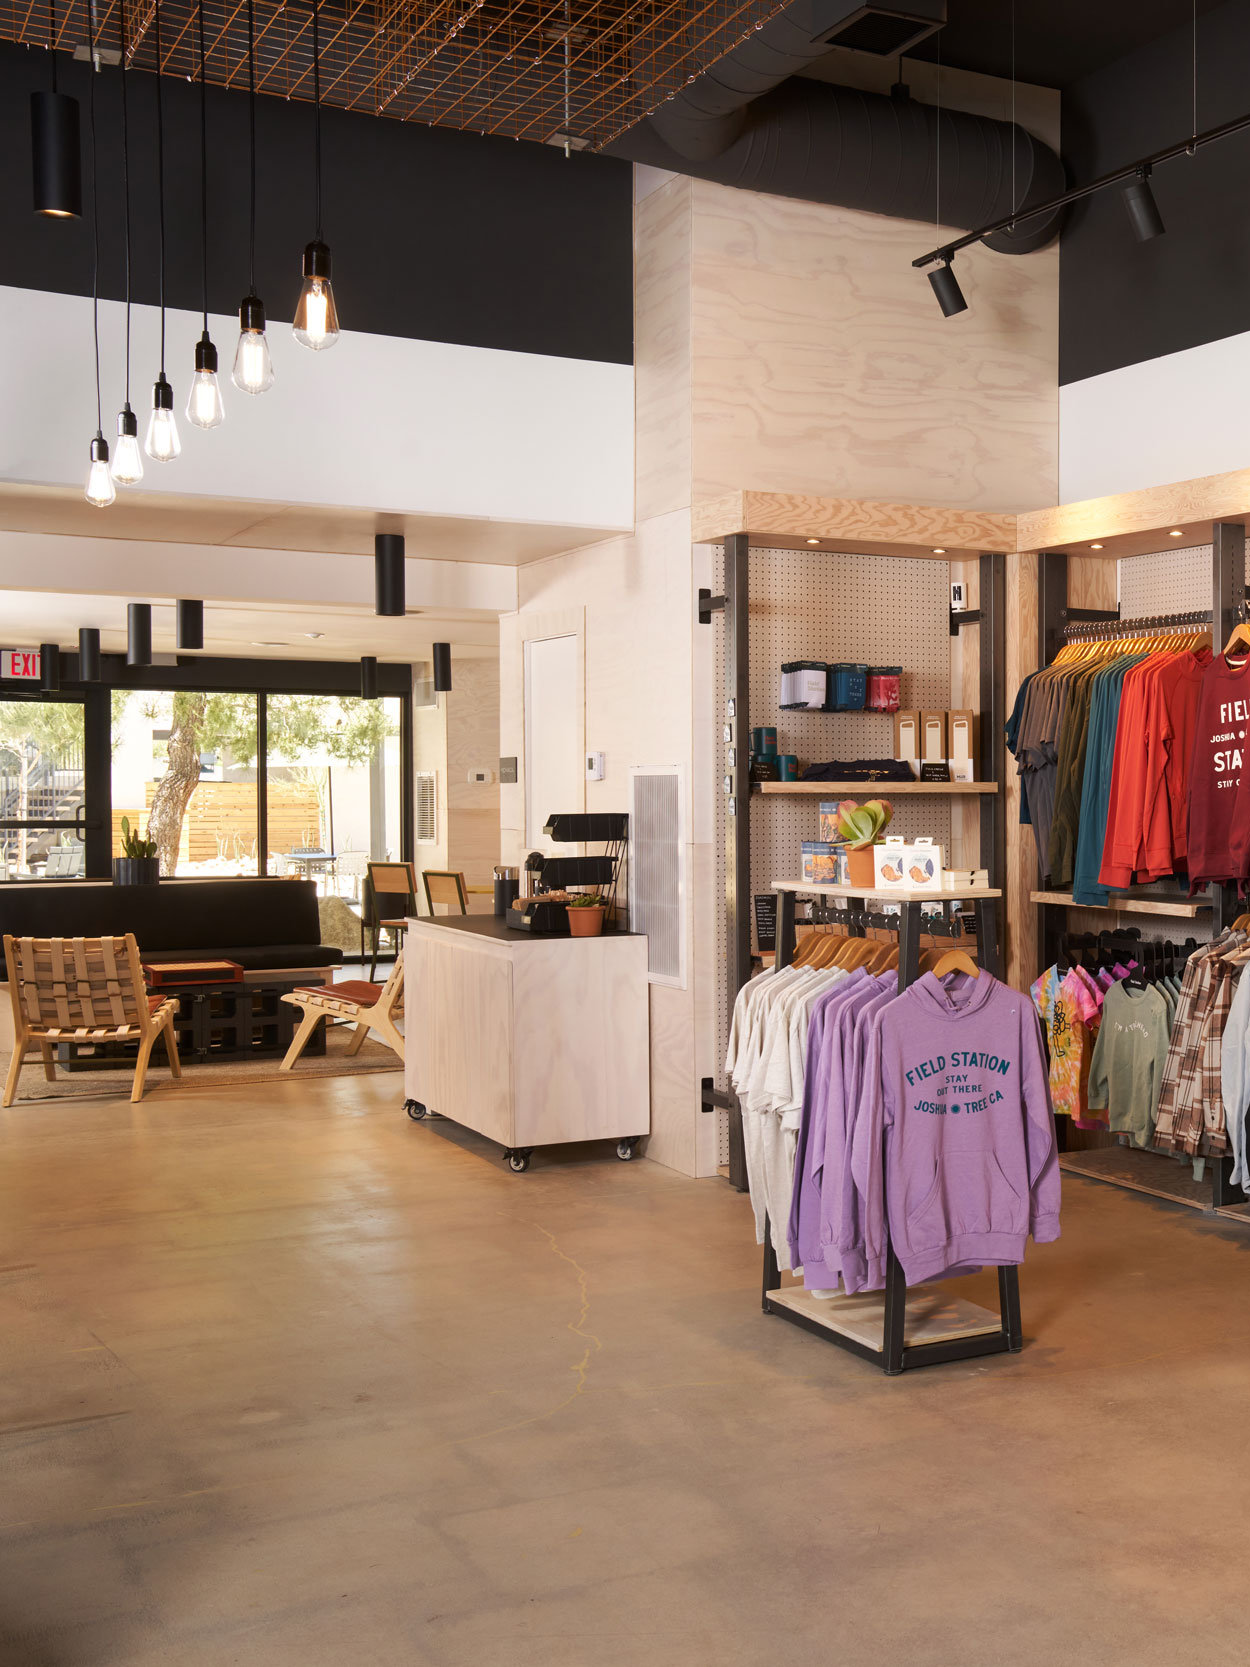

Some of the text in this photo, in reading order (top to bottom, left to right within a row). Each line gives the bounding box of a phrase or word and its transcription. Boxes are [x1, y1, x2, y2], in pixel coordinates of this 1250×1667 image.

[11, 652, 40, 676] EXI
[1214, 748, 1244, 772] STA
[906, 1052, 1010, 1086] FIELD STATION
[946, 1074, 968, 1084] STAY
[937, 1084, 982, 1096] OUT THERE
[914, 1090, 1004, 1115] JOSHUA TREE CA
